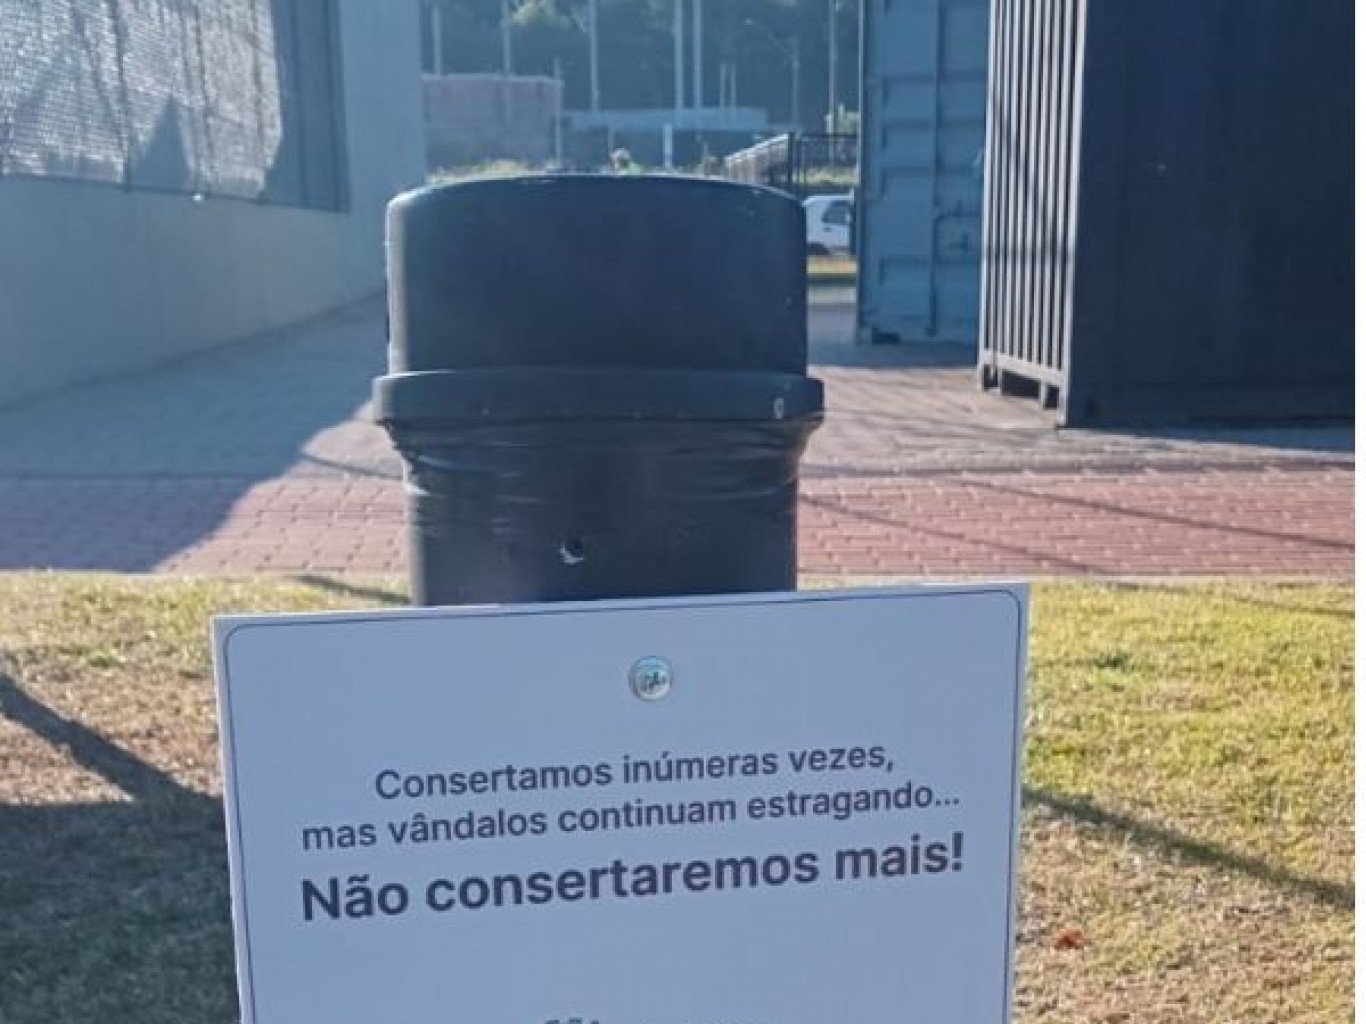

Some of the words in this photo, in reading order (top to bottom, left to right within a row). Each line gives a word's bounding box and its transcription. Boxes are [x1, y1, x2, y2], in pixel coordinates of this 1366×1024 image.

[376, 763, 613, 799] Consertamos
[624, 751, 777, 783] inúmeras
[788, 747, 893, 772] vezes,
[303, 824, 376, 851] mas
[387, 808, 547, 844] vândalos
[558, 799, 736, 833] continuam
[747, 781, 959, 820] estragando...
[302, 874, 408, 922] Não
[426, 852, 820, 911] consertaremos
[836, 831, 963, 879] mais!
